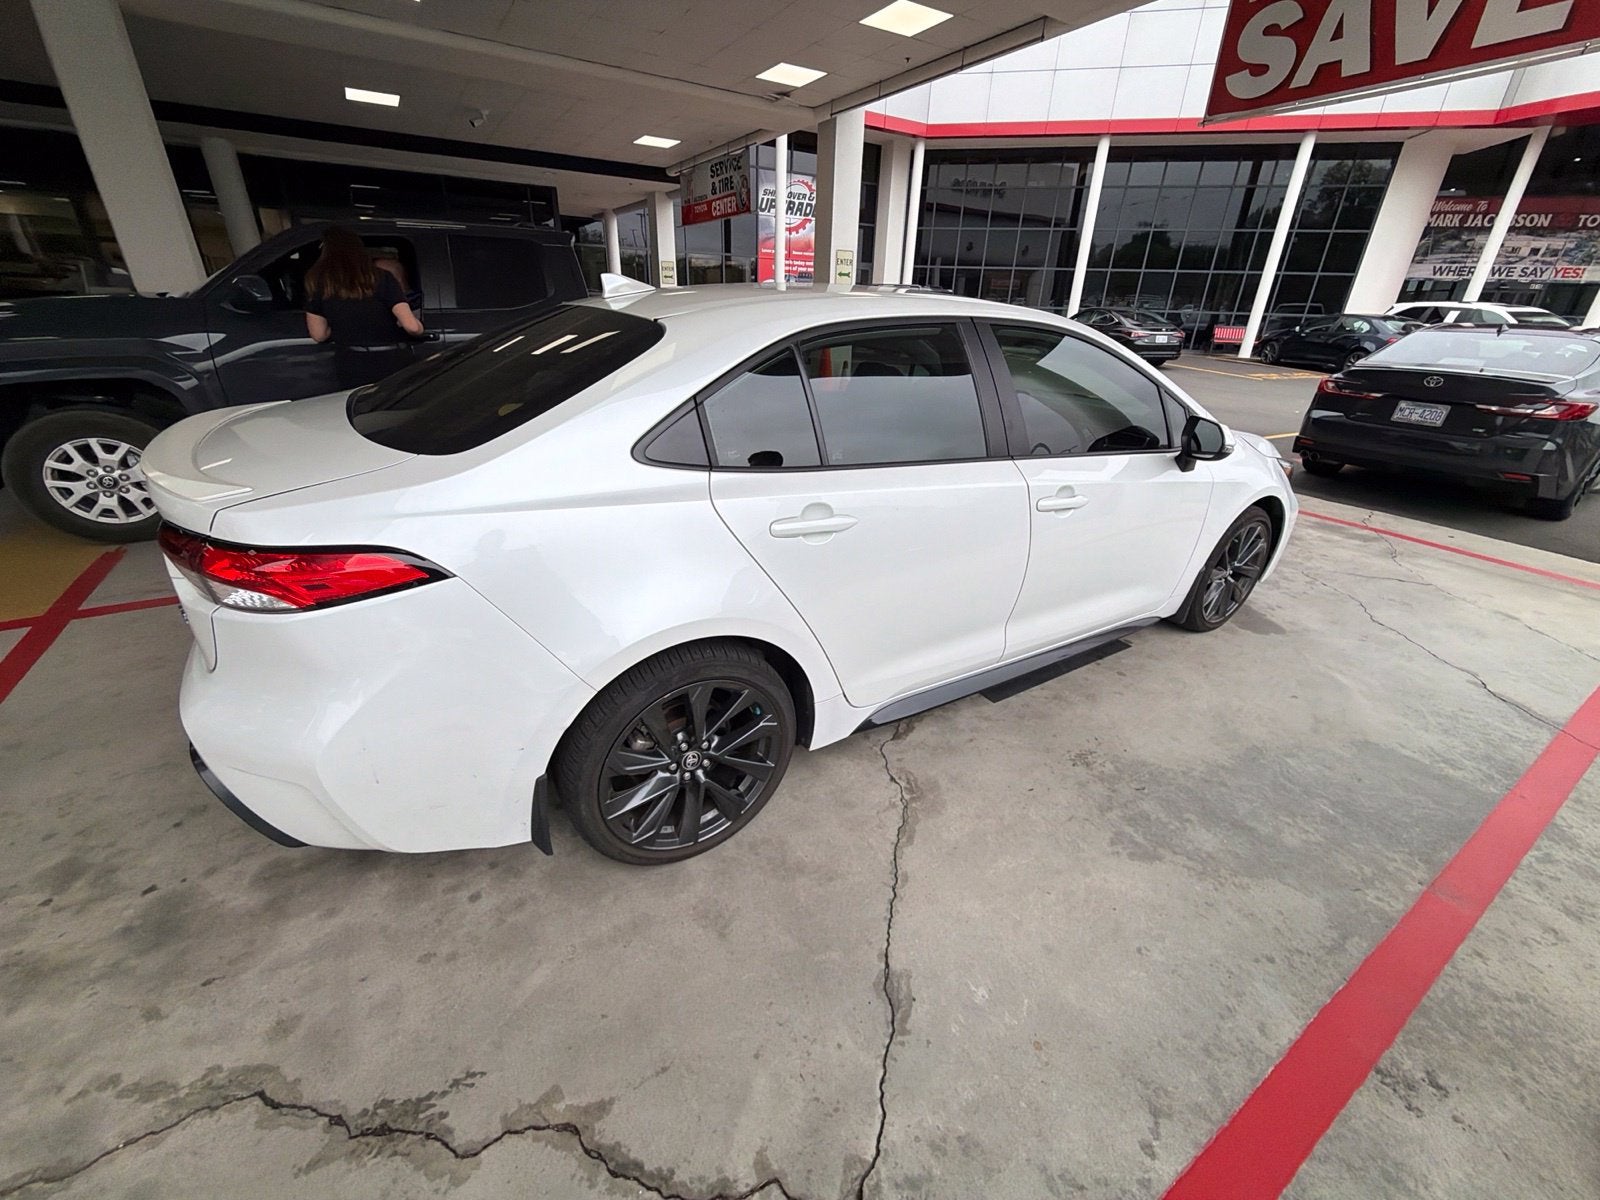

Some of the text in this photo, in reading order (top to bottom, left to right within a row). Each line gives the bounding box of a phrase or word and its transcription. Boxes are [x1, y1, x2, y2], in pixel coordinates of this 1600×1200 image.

[710, 156, 742, 178] SERVICE
[711, 175, 735, 196] & TIRE
[787, 191, 807, 201] OVER
[808, 191, 816, 202] &
[711, 195, 737, 217] CENTER
[759, 197, 816, 217] UPRAD
[1432, 200, 1489, 212] Welcome To
[1429, 213, 1464, 227] MARK
[1463, 213, 1553, 228] JACSON
[836, 258, 854, 266] ENTER
[1432, 265, 1586, 279] WHER WE SAY YES!
